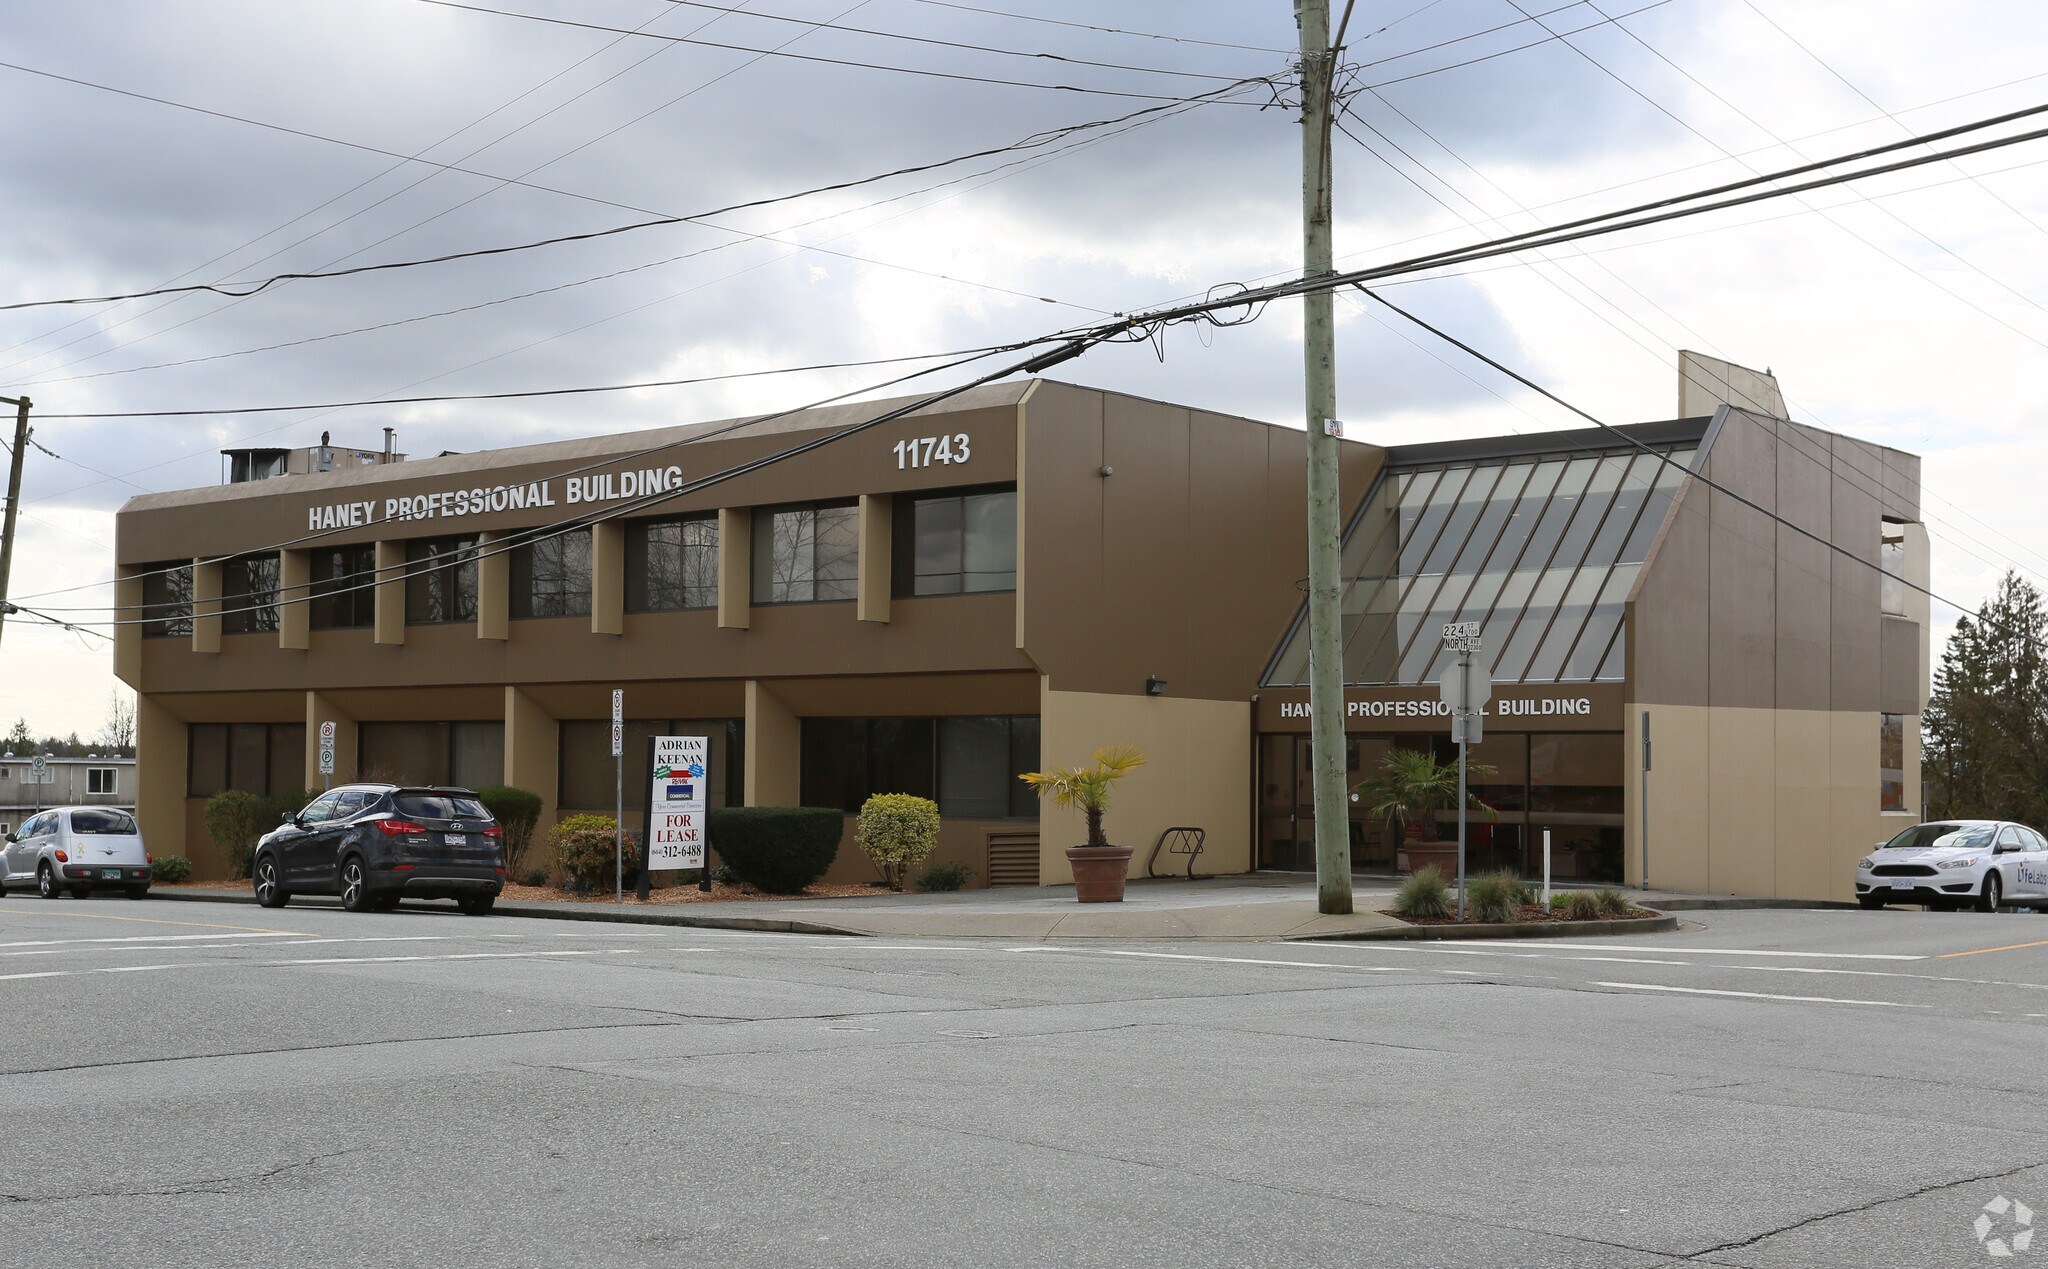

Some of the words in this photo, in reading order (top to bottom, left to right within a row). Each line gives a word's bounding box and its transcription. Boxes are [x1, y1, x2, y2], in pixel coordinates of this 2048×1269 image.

[893, 433, 971, 470] 11743
[308, 501, 376, 531] HANEY
[385, 481, 556, 523] PROFESSIONAL
[566, 465, 683, 504] BUILDING
[1443, 625, 1464, 637] 224
[1445, 638, 1469, 650] NORTH
[1281, 702, 1312, 718] HAN
[1347, 700, 1490, 717] PROFESSIOL
[1498, 697, 1591, 716] BUILDING
[659, 740, 702, 750] ADRIAN
[657, 754, 703, 765] KEENAN
[666, 814, 692, 828] FOR
[657, 829, 699, 843] LEASE
